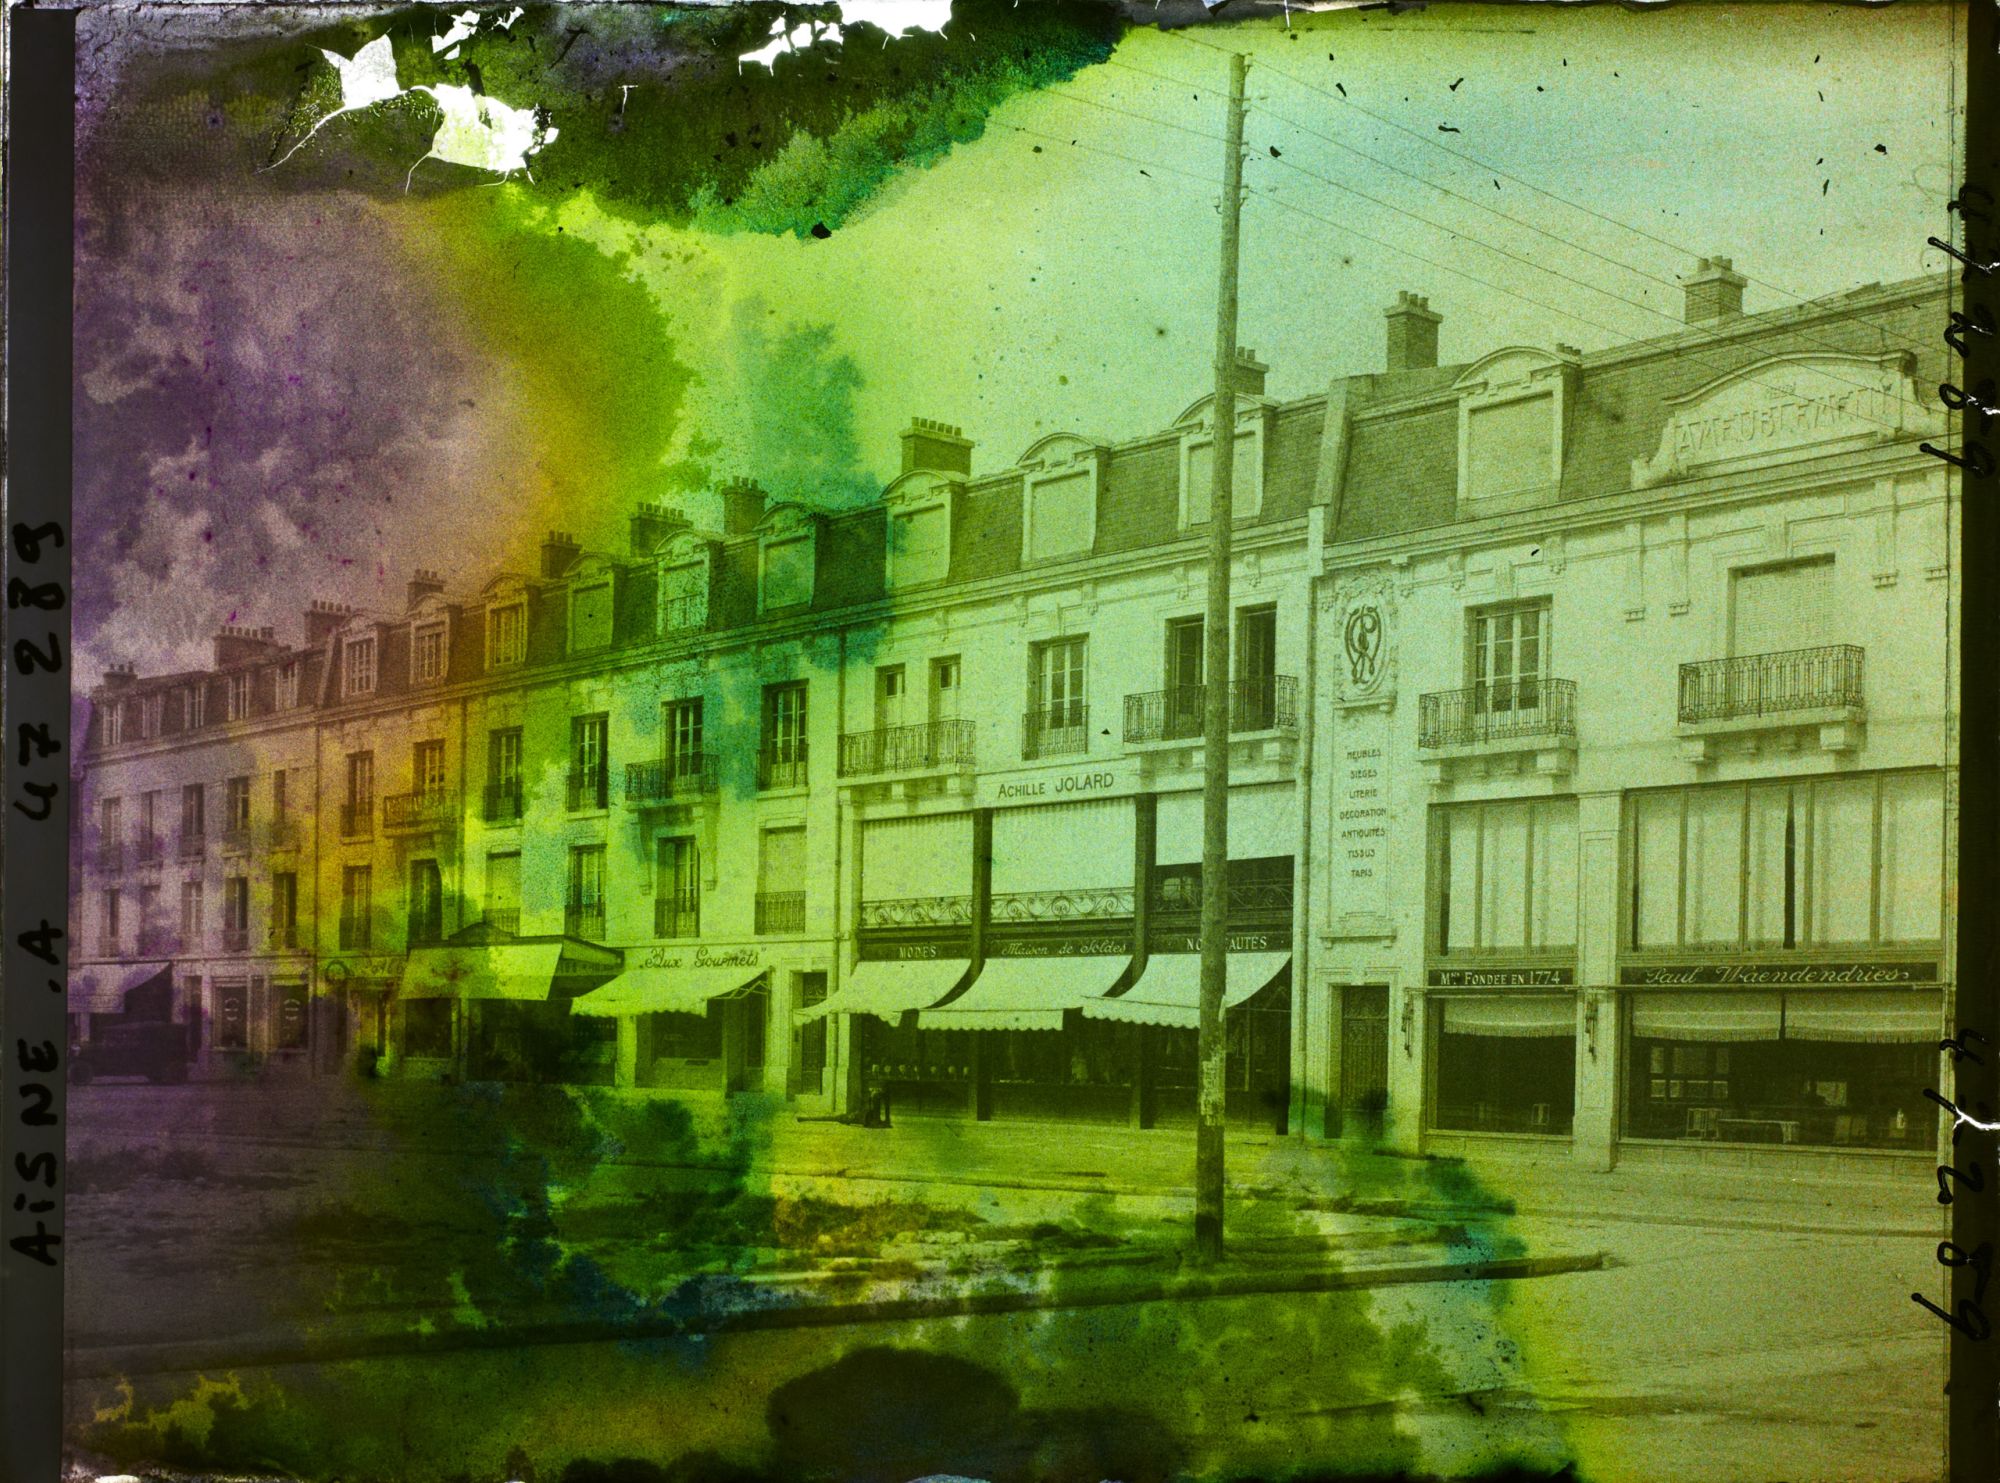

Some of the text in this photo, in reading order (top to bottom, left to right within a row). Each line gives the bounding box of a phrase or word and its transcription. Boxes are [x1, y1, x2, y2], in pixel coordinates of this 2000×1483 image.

[1346, 748, 1382, 760] MEUBLES
[998, 773, 1114, 798] ACHILLE JOLARD
[1349, 788, 1378, 799] LITERIE
[1347, 848, 1375, 858] TISSUS
[1351, 868, 1373, 878] TAPIS
[899, 945, 937, 958] MODES
[1001, 939, 1127, 955] Maison de Soldes
[644, 945, 760, 969] Aux Gourmets
[1511, 974, 1525, 985] EN
[1529, 970, 1560, 985] 1774
[1645, 966, 1704, 984] Paul
